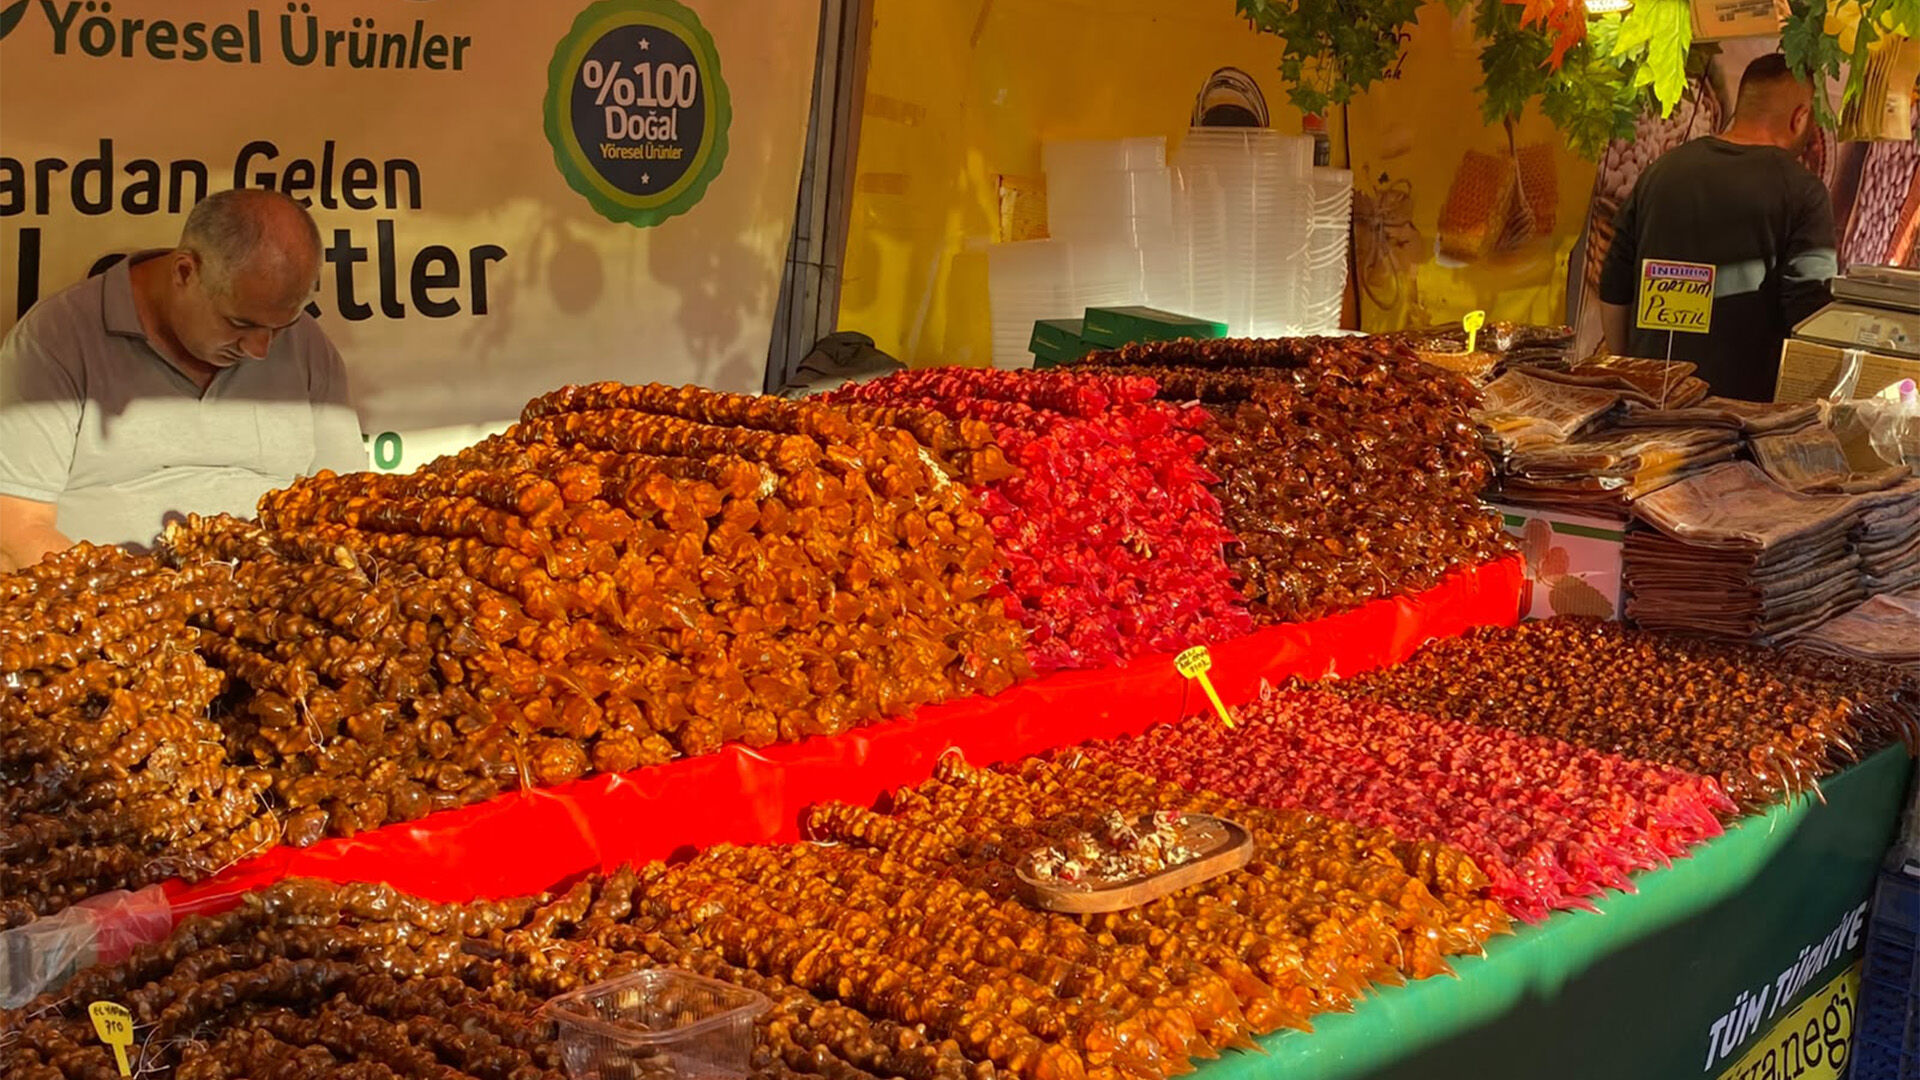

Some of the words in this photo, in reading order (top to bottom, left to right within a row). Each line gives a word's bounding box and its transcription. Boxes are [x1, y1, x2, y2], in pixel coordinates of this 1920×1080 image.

[40, 0, 261, 64] Yöresel
[281, 2, 471, 71] Ürünler
[582, 60, 697, 108] %100
[233, 140, 422, 210] Gelen
[600, 142, 644, 159] Yöresel
[645, 142, 683, 160] Ürünler
[1704, 983, 1771, 1072] TÜM
[1767, 900, 1868, 1019] TÜRKİYE
